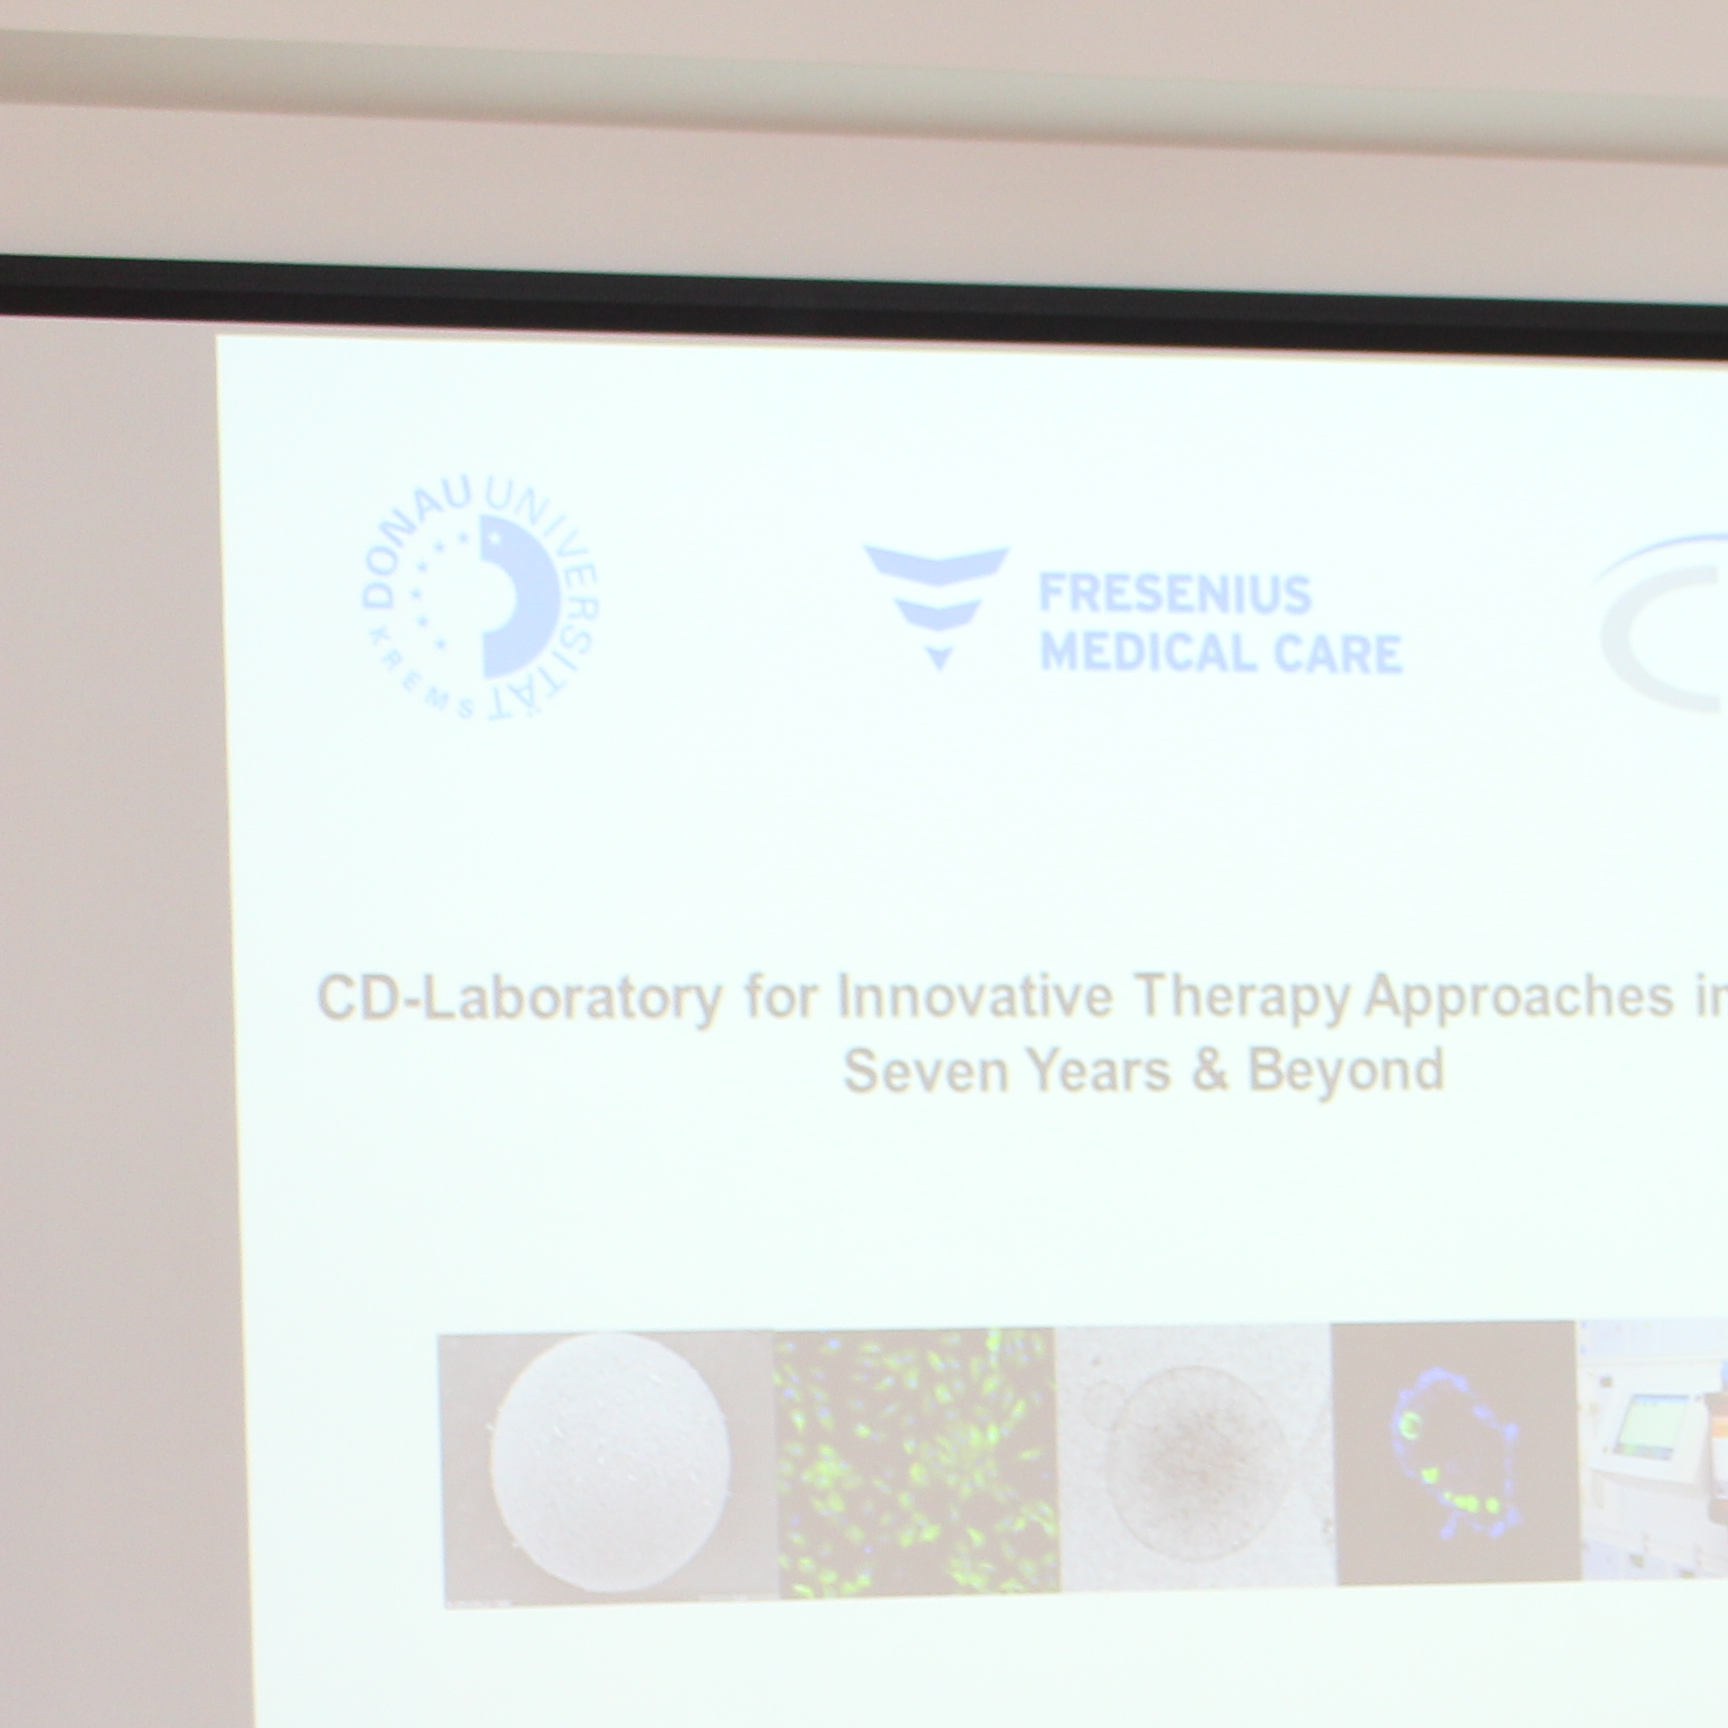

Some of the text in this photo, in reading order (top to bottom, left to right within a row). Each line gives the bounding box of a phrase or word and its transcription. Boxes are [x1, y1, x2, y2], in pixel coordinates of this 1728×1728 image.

[361, 473, 602, 722] DONAU UNIVERSITÄT
[1039, 571, 1313, 616] FRESENIUS
[368, 624, 475, 720] KREMS
[1040, 630, 1404, 675] MEDICAL CARE
[317, 972, 724, 1032] CD-Laboratory
[743, 971, 820, 1019] for
[838, 971, 1114, 1019] Innovative
[1133, 971, 1352, 1029] Therapy
[1363, 971, 1675, 1029] Approaches
[844, 1045, 1444, 1104] Seven Years & Beyond
